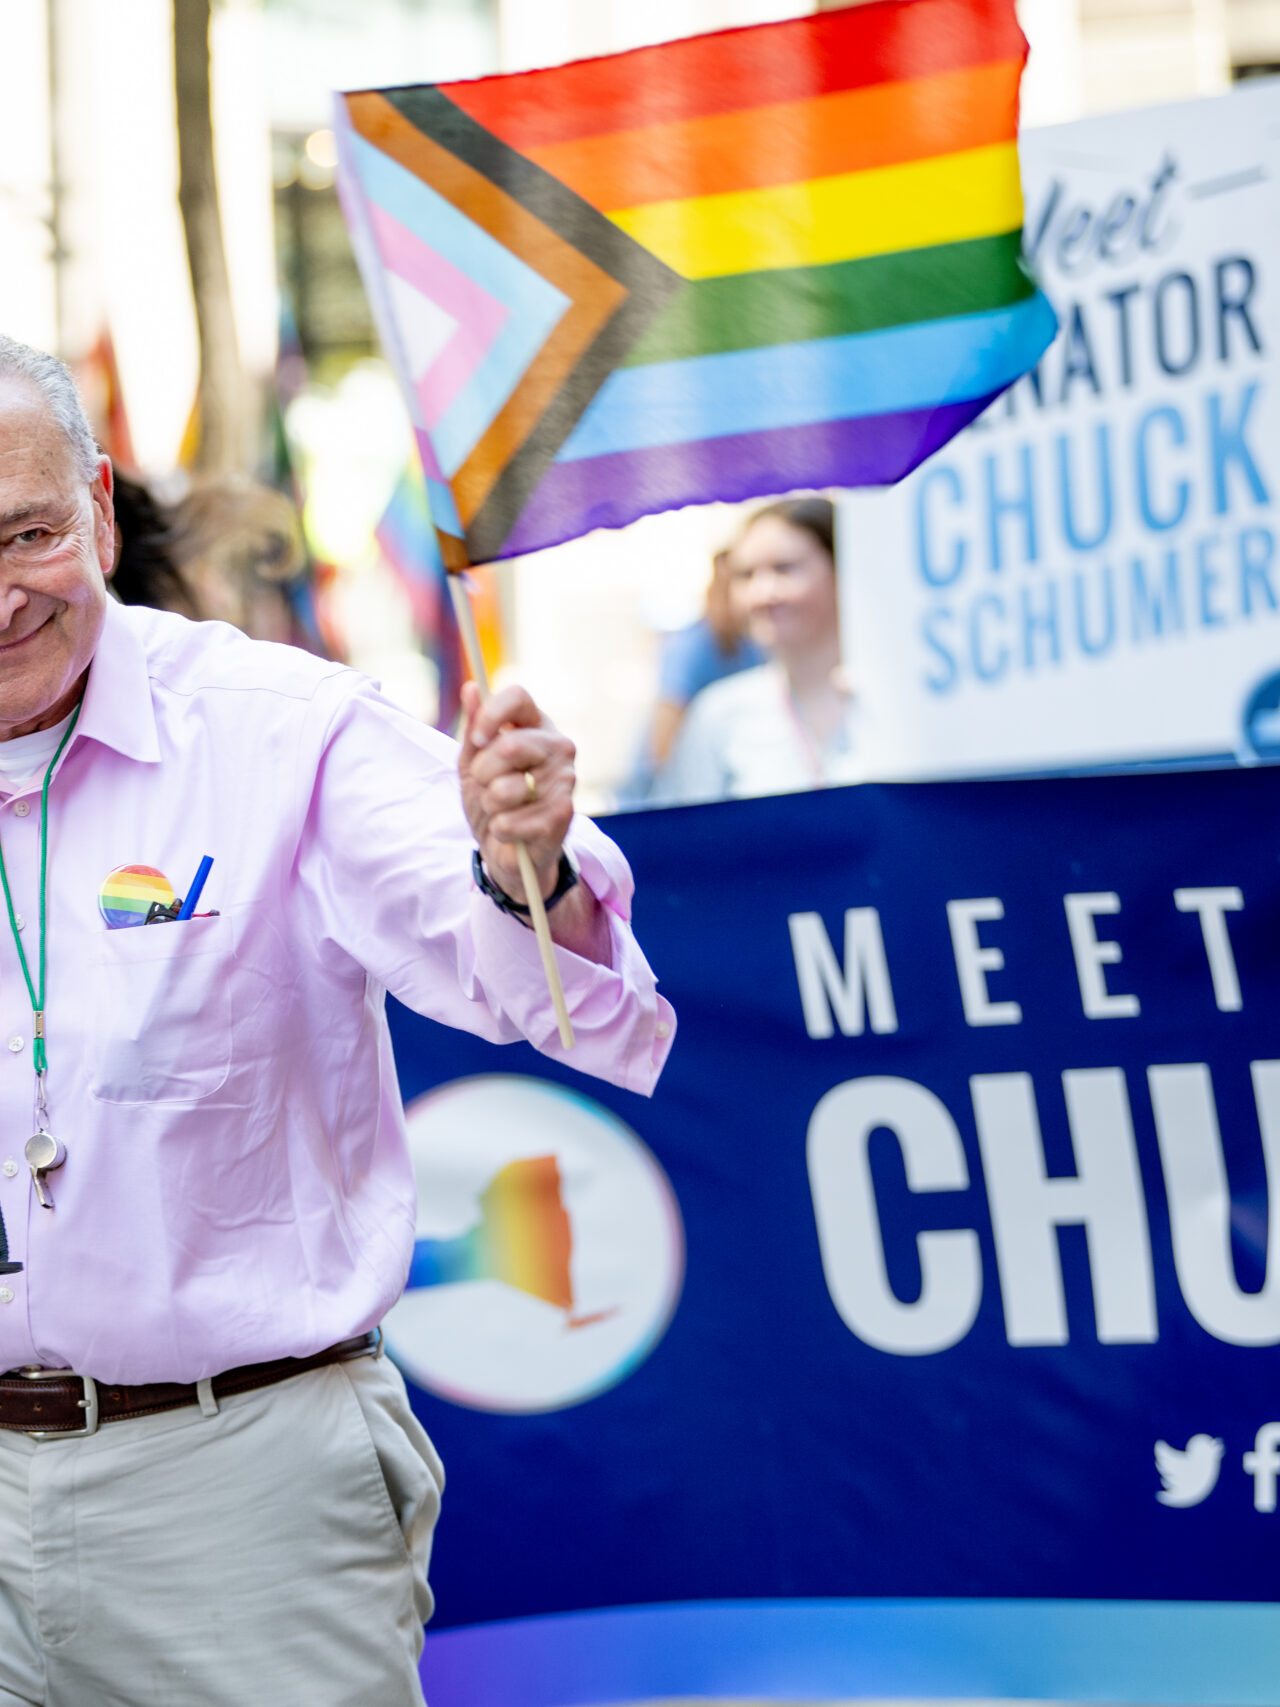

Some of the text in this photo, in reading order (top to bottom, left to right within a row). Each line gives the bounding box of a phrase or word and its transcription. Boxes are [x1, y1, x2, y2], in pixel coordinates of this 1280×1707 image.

[915, 378, 1272, 588] CHUCK
[919, 526, 1279, 696] SCHUMER
[787, 885, 1245, 1040] MEET
